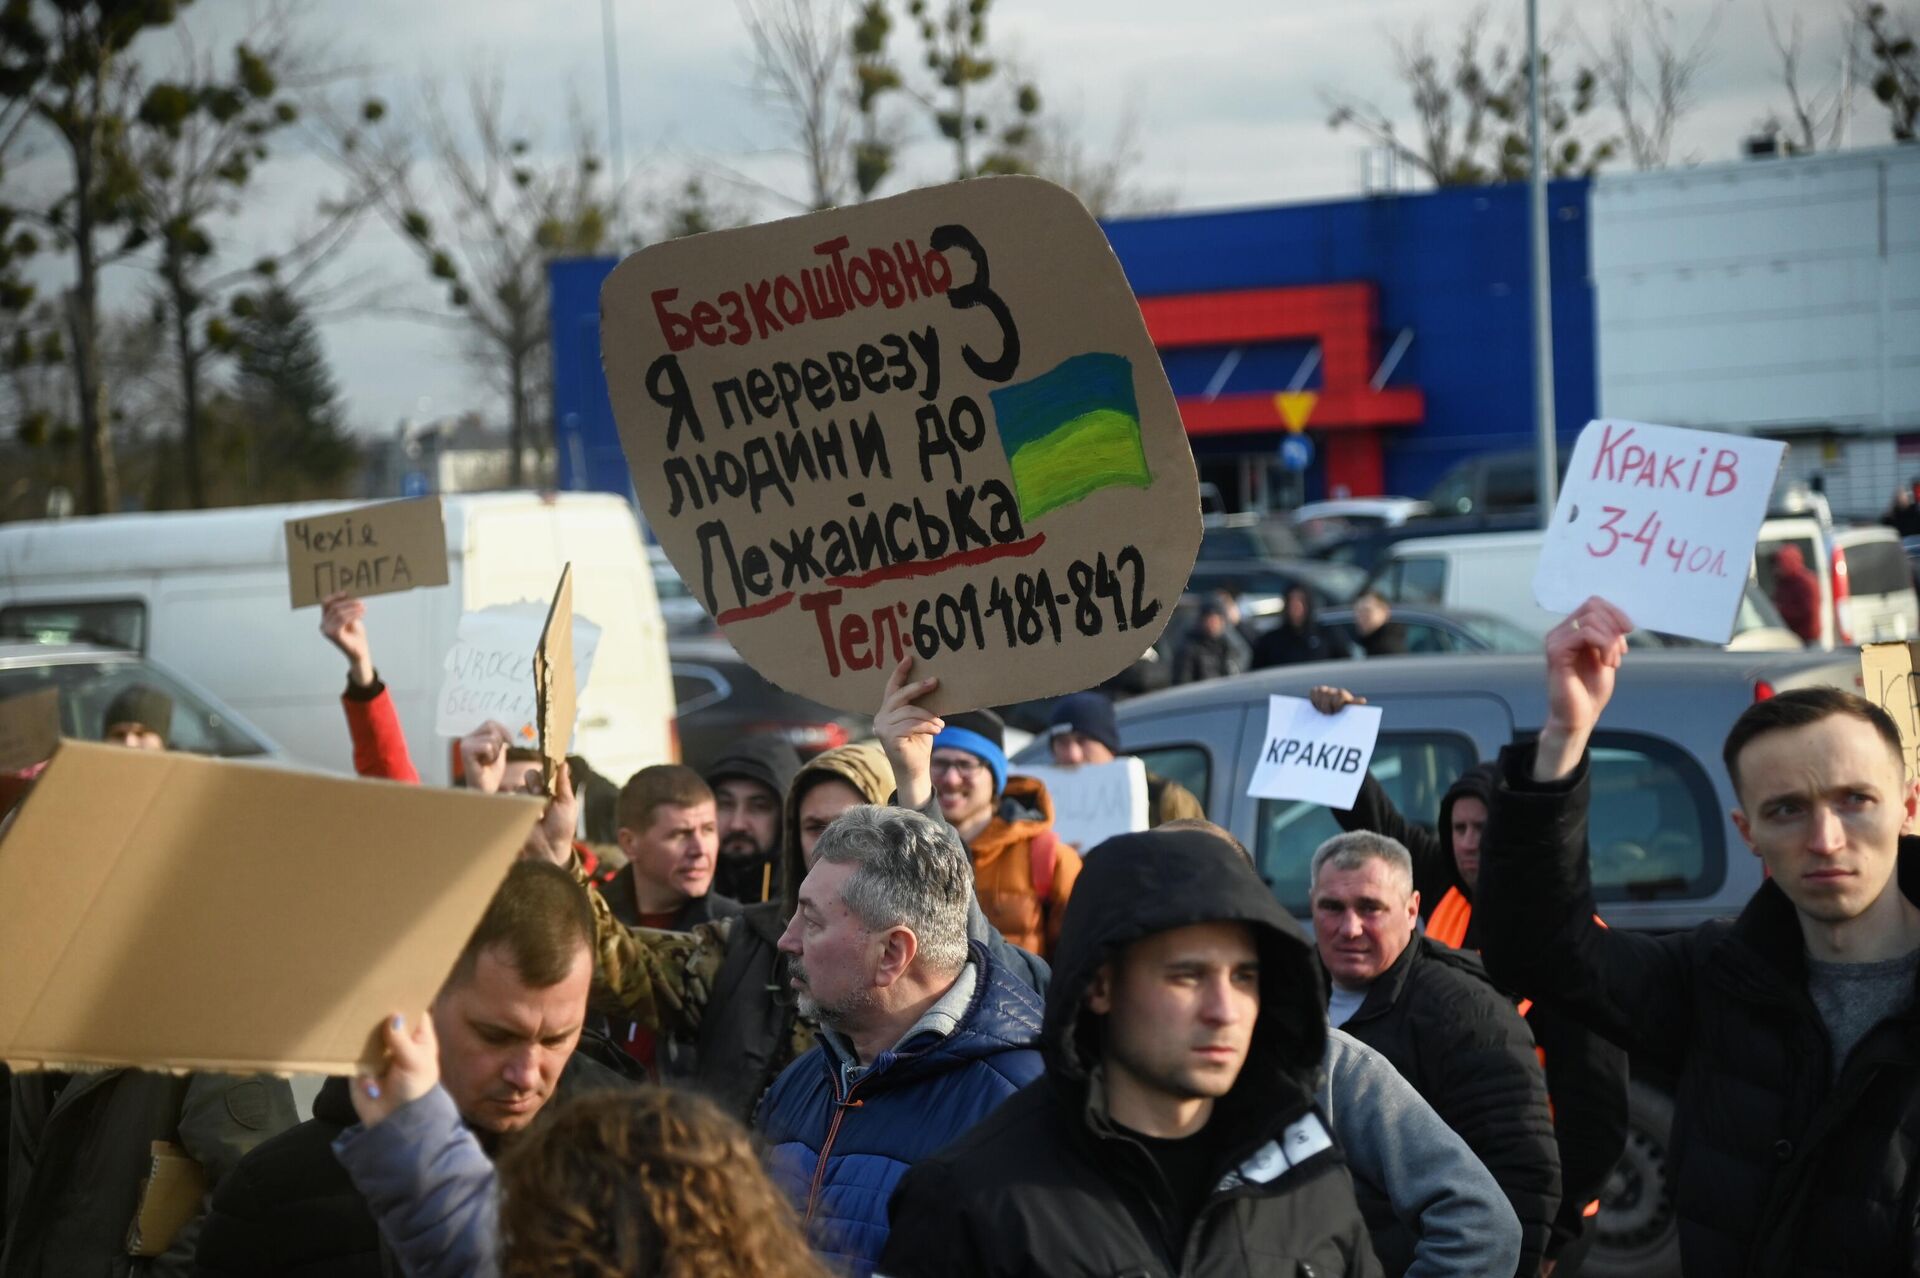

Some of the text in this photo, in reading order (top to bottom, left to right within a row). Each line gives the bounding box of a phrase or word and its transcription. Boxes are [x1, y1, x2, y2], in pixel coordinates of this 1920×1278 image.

[651, 236, 953, 352] Безкоштовно
[645, 354, 705, 451] Я
[712, 325, 941, 430] перевезу
[663, 396, 986, 518] людини до
[696, 479, 1025, 617] Лежайська
[1266, 737, 1363, 775] КРАКІВ
